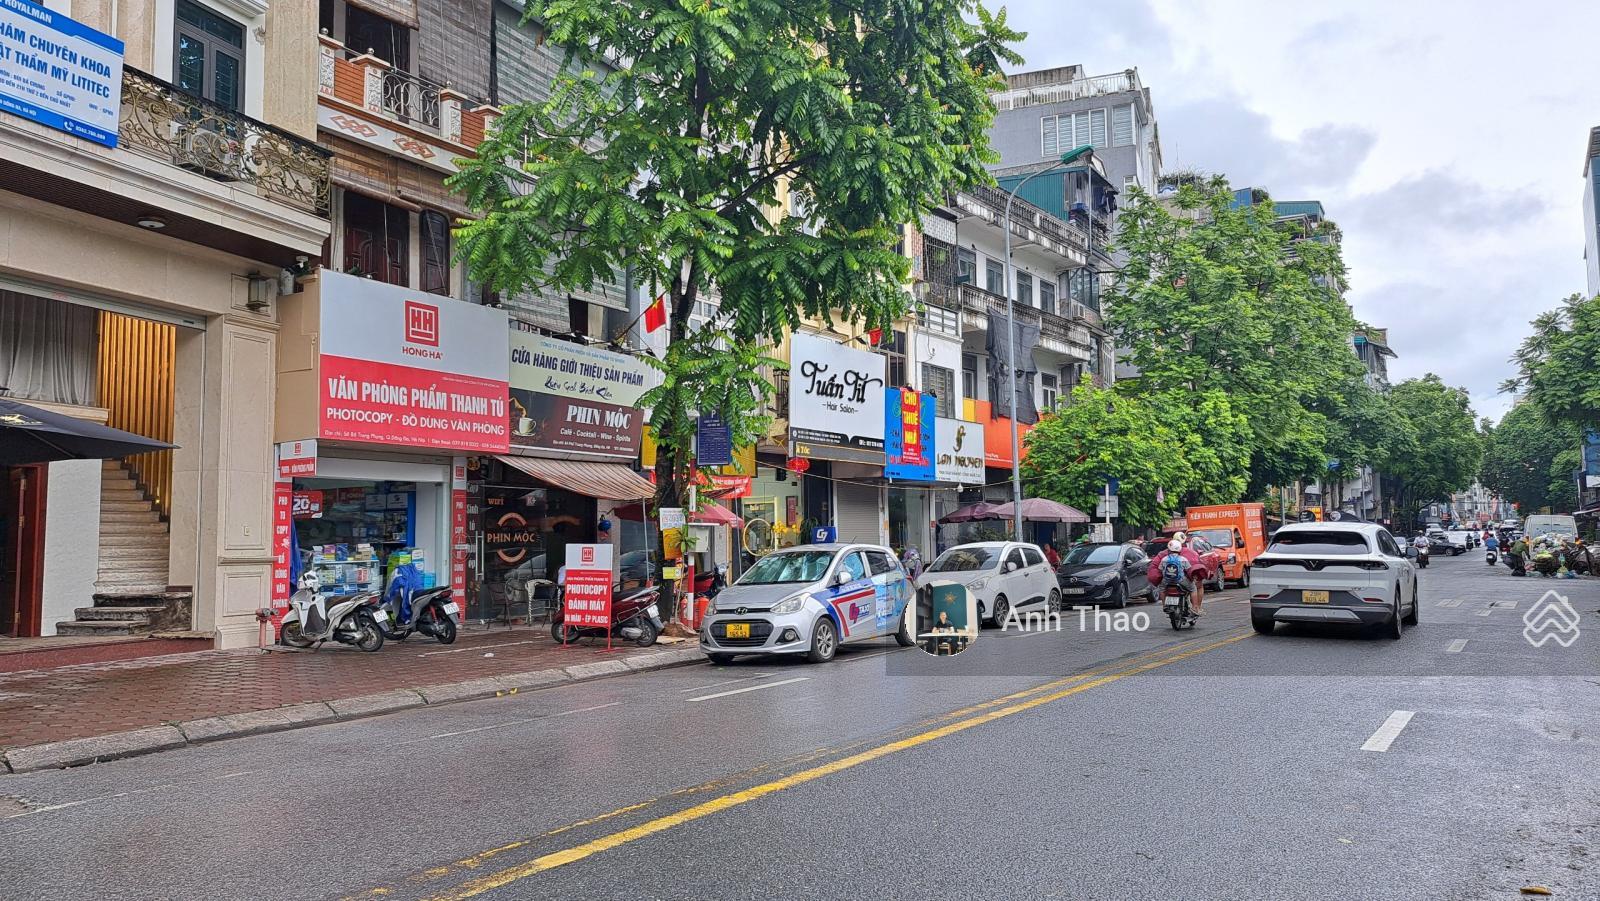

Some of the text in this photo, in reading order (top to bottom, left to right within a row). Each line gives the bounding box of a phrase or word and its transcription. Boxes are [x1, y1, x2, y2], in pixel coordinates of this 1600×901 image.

[29, 34, 77, 64] CHUYÊN
[81, 56, 111, 78] KHOA
[15, 50, 48, 74] THẨM
[51, 65, 69, 82] MỸ
[72, 73, 110, 98] LITITEC
[512, 346, 530, 366] CỬA
[533, 351, 557, 370] HÀNG
[560, 356, 577, 375] GIỚI
[580, 362, 602, 381] THIỆU
[604, 365, 620, 382] SẢN
[801, 360, 844, 398] Tuấn
[328, 375, 504, 417] VĂN PHÒNG PHẨM THANH TÚ
[904, 392, 916, 406] CHO
[327, 407, 393, 424] PHOTOCOPY
[402, 412, 418, 426] ĐỒ
[420, 416, 448, 429] DÙNG
[451, 419, 470, 432] VĂN
[472, 421, 504, 435] PHÒNG
[565, 405, 632, 432] PHIN MỘC
[487, 533, 511, 543] PHIN
[566, 584, 608, 595] PHOTOCOPY
[568, 598, 605, 611] ĐÁNH MÁY
